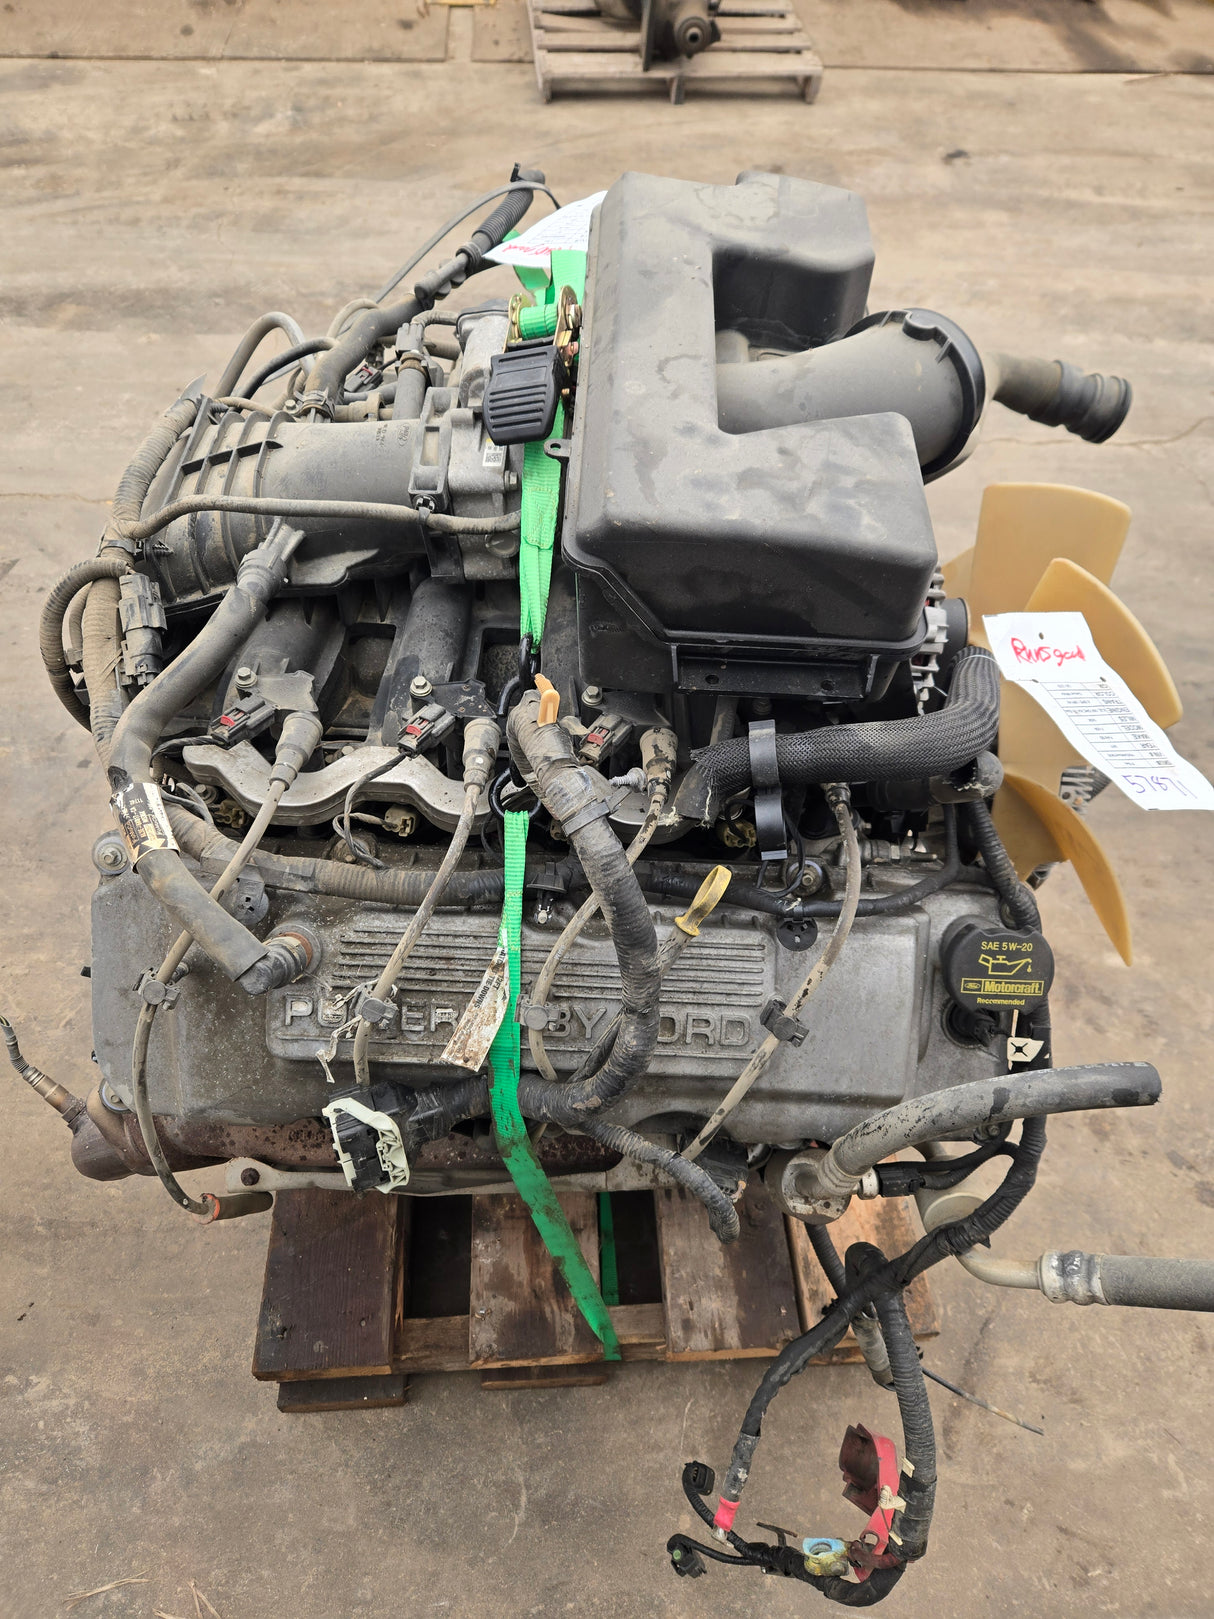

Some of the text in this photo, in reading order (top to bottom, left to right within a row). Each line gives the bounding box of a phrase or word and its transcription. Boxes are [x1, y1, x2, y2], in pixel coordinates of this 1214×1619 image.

[981, 941, 1033, 952] SAE 5W-20
[976, 997, 1026, 1006] Recommended
[657, 1009, 752, 1048] ORD
